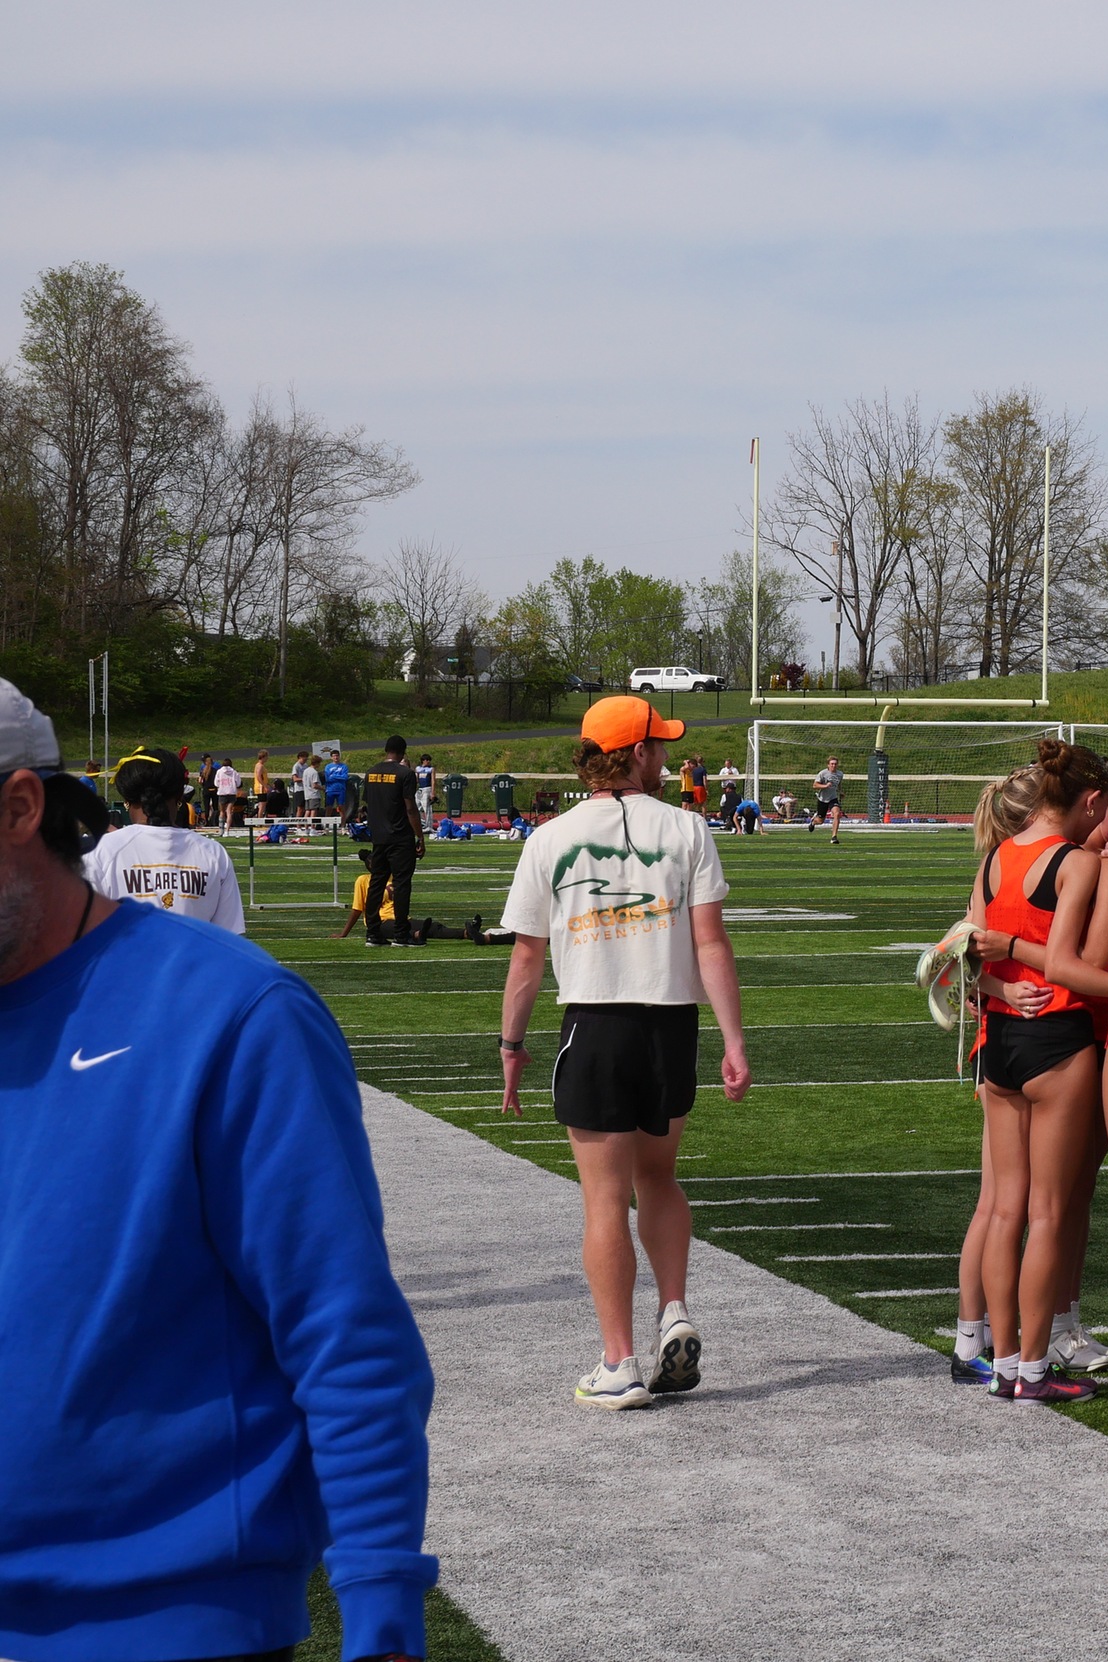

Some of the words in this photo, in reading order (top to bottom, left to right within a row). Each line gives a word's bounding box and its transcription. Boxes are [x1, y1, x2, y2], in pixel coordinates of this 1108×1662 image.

[123, 869, 153, 893] WE
[155, 872, 178, 889] ARE
[180, 870, 209, 896] ONE
[567, 906, 645, 932] adidas
[572, 917, 676, 946] ADVENTURE
